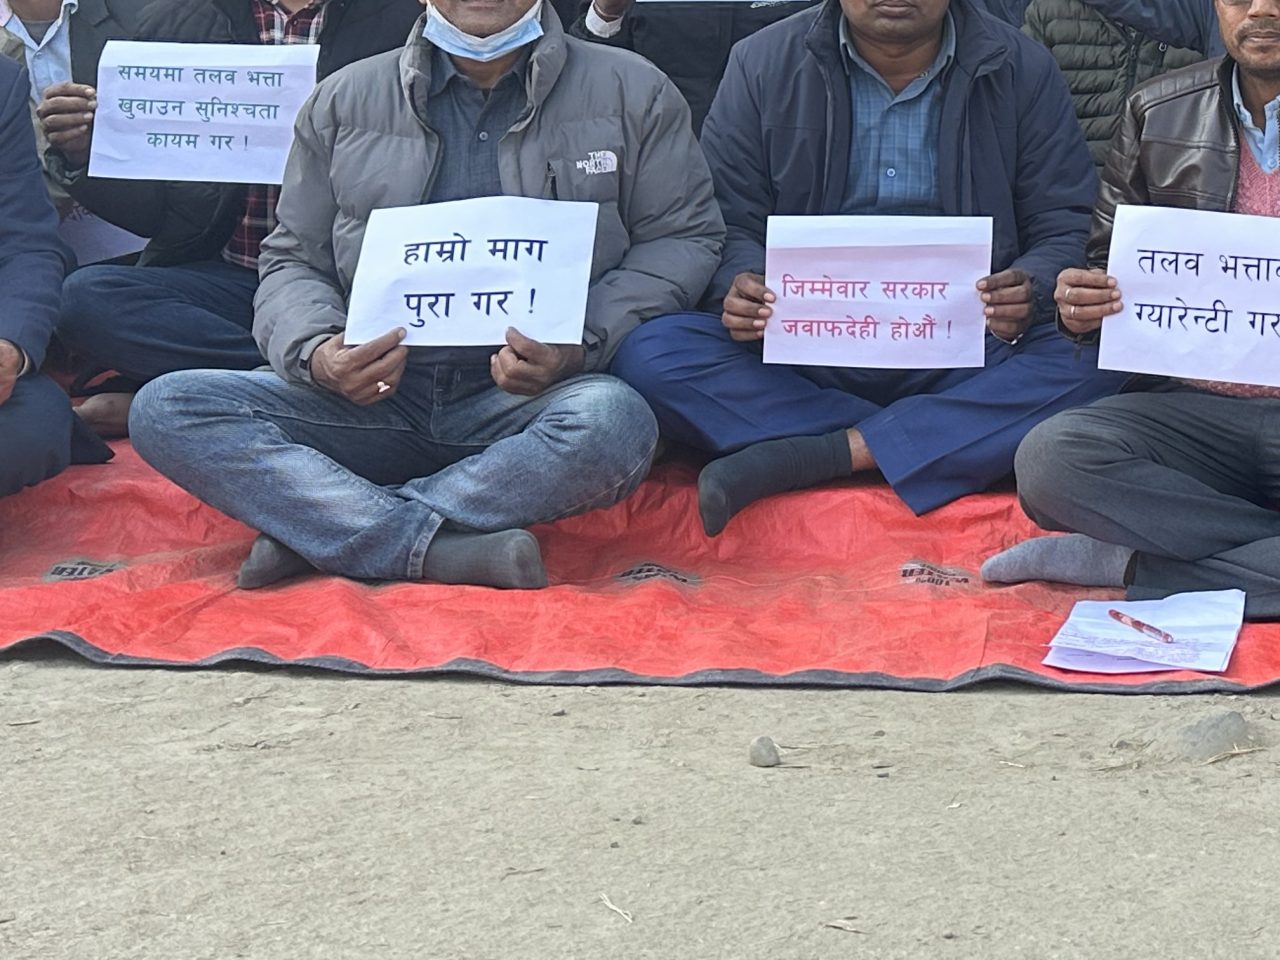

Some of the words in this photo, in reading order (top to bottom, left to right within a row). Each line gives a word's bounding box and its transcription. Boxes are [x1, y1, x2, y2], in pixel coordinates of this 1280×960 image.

[117, 65, 185, 83] समयमा
[192, 68, 238, 85] तलव
[246, 70, 285, 88] भत्ता
[117, 97, 186, 120] खुवाउन
[146, 132, 201, 149] कायम
[209, 134, 235, 151] गर
[403, 232, 472, 266] हाम्रो
[486, 238, 549, 263] माग
[1136, 249, 1205, 277] तलव
[781, 273, 871, 299] जिम्मेवार
[880, 281, 950, 300] सरकार
[403, 292, 456, 328] पुरा
[470, 290, 514, 316] गर
[1133, 296, 1234, 334] ग्यारेन्टी
[780, 314, 881, 340] जवाफदेही
